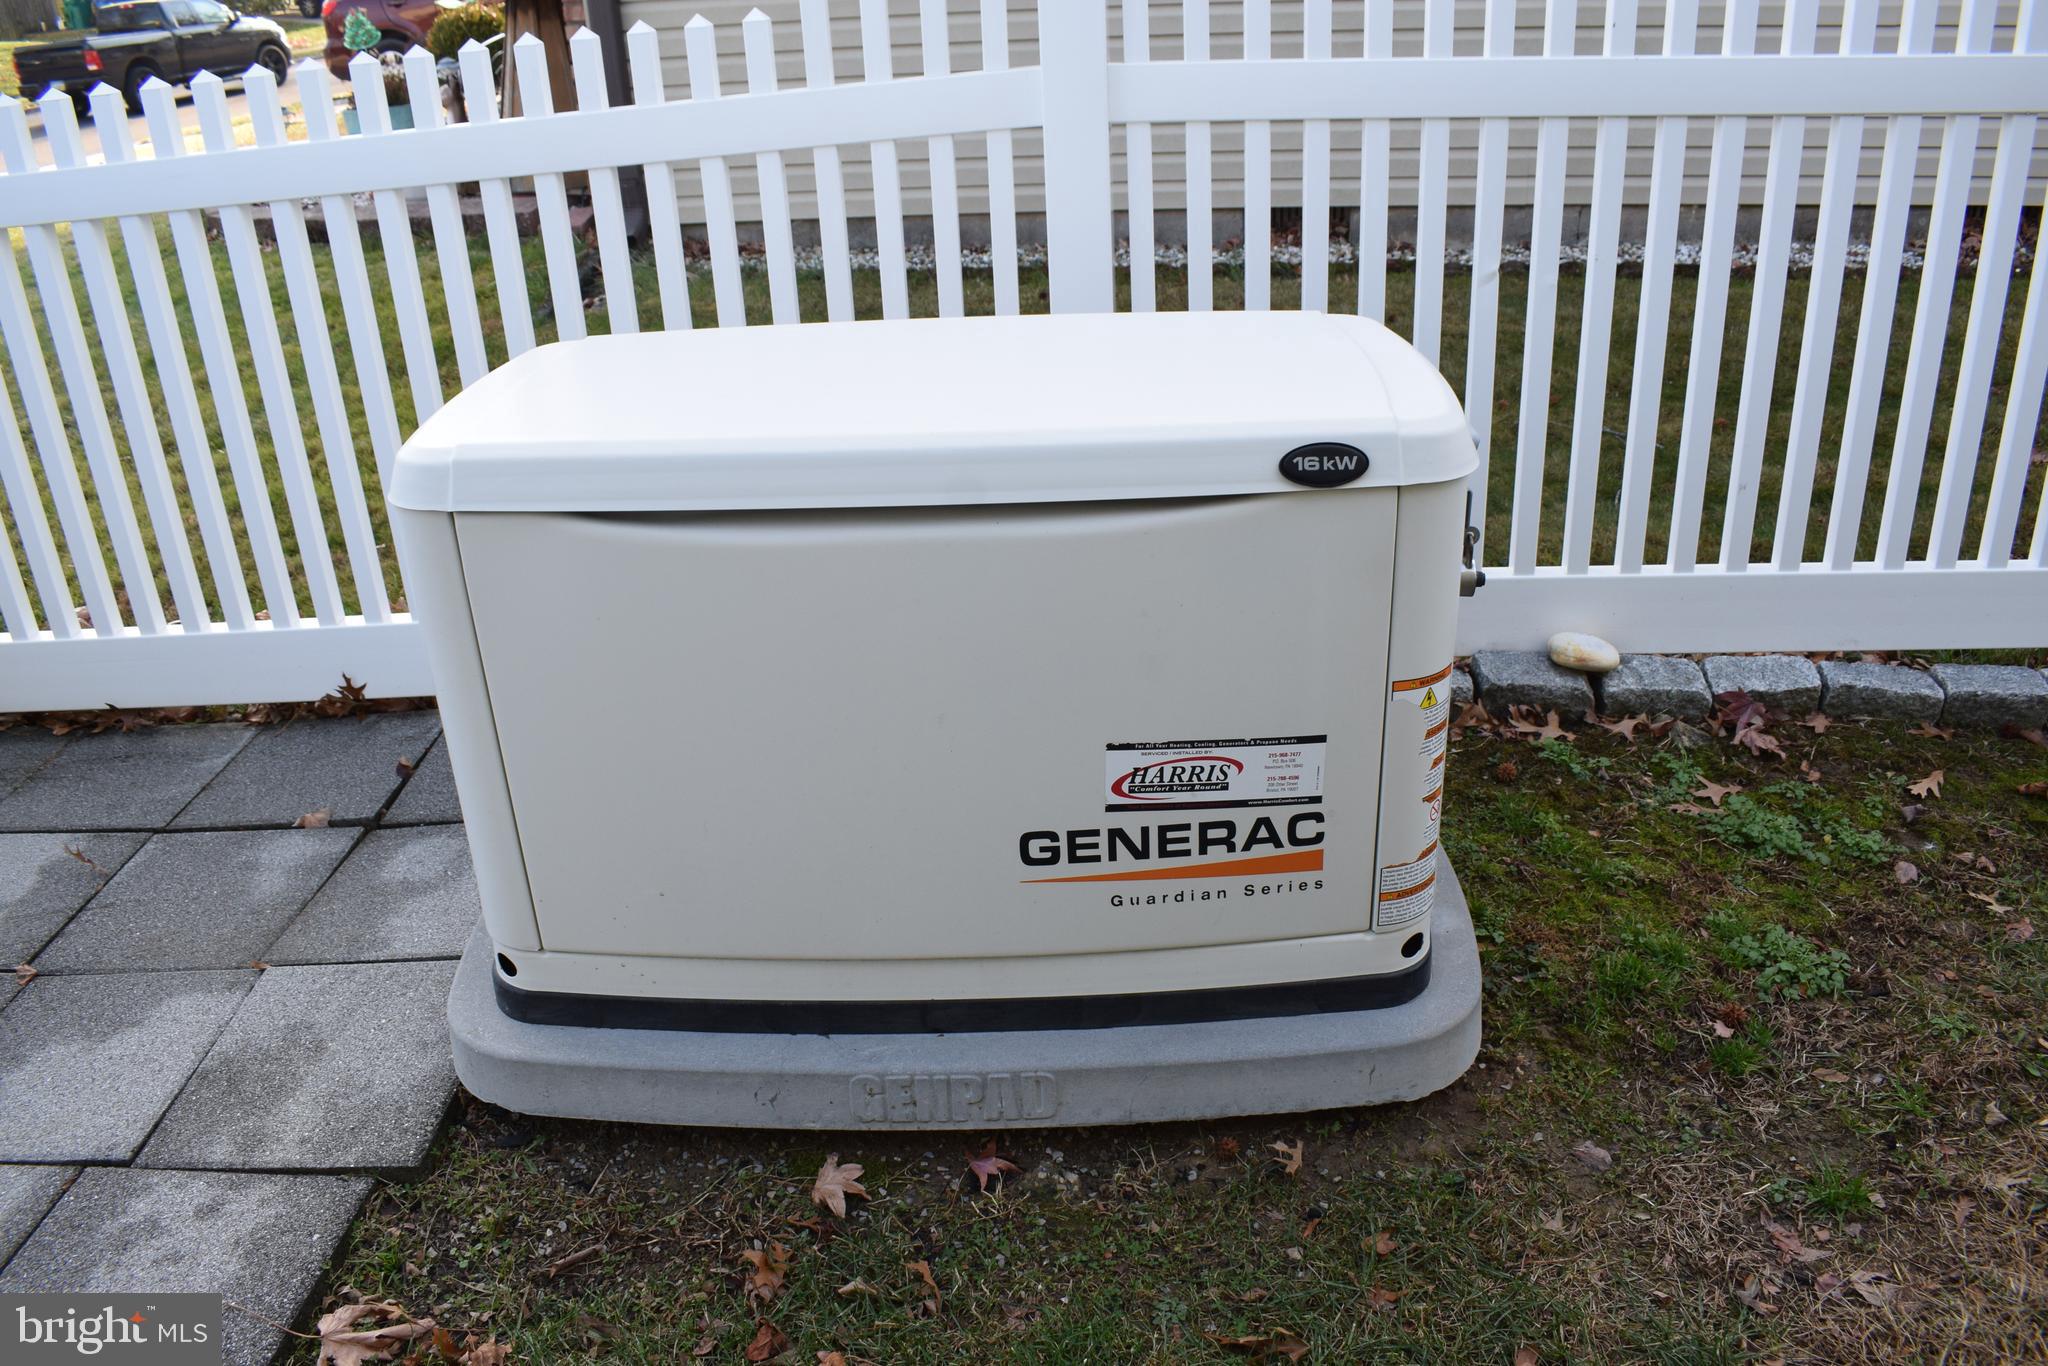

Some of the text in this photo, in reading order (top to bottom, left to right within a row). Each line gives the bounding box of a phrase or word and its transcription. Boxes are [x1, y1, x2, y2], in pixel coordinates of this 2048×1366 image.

[1292, 455, 1358, 471] 16 kW
[1128, 764, 1231, 784] HARRIS
[1019, 811, 1326, 867] GENERAC
[1110, 879, 1324, 907] Guardian Series
